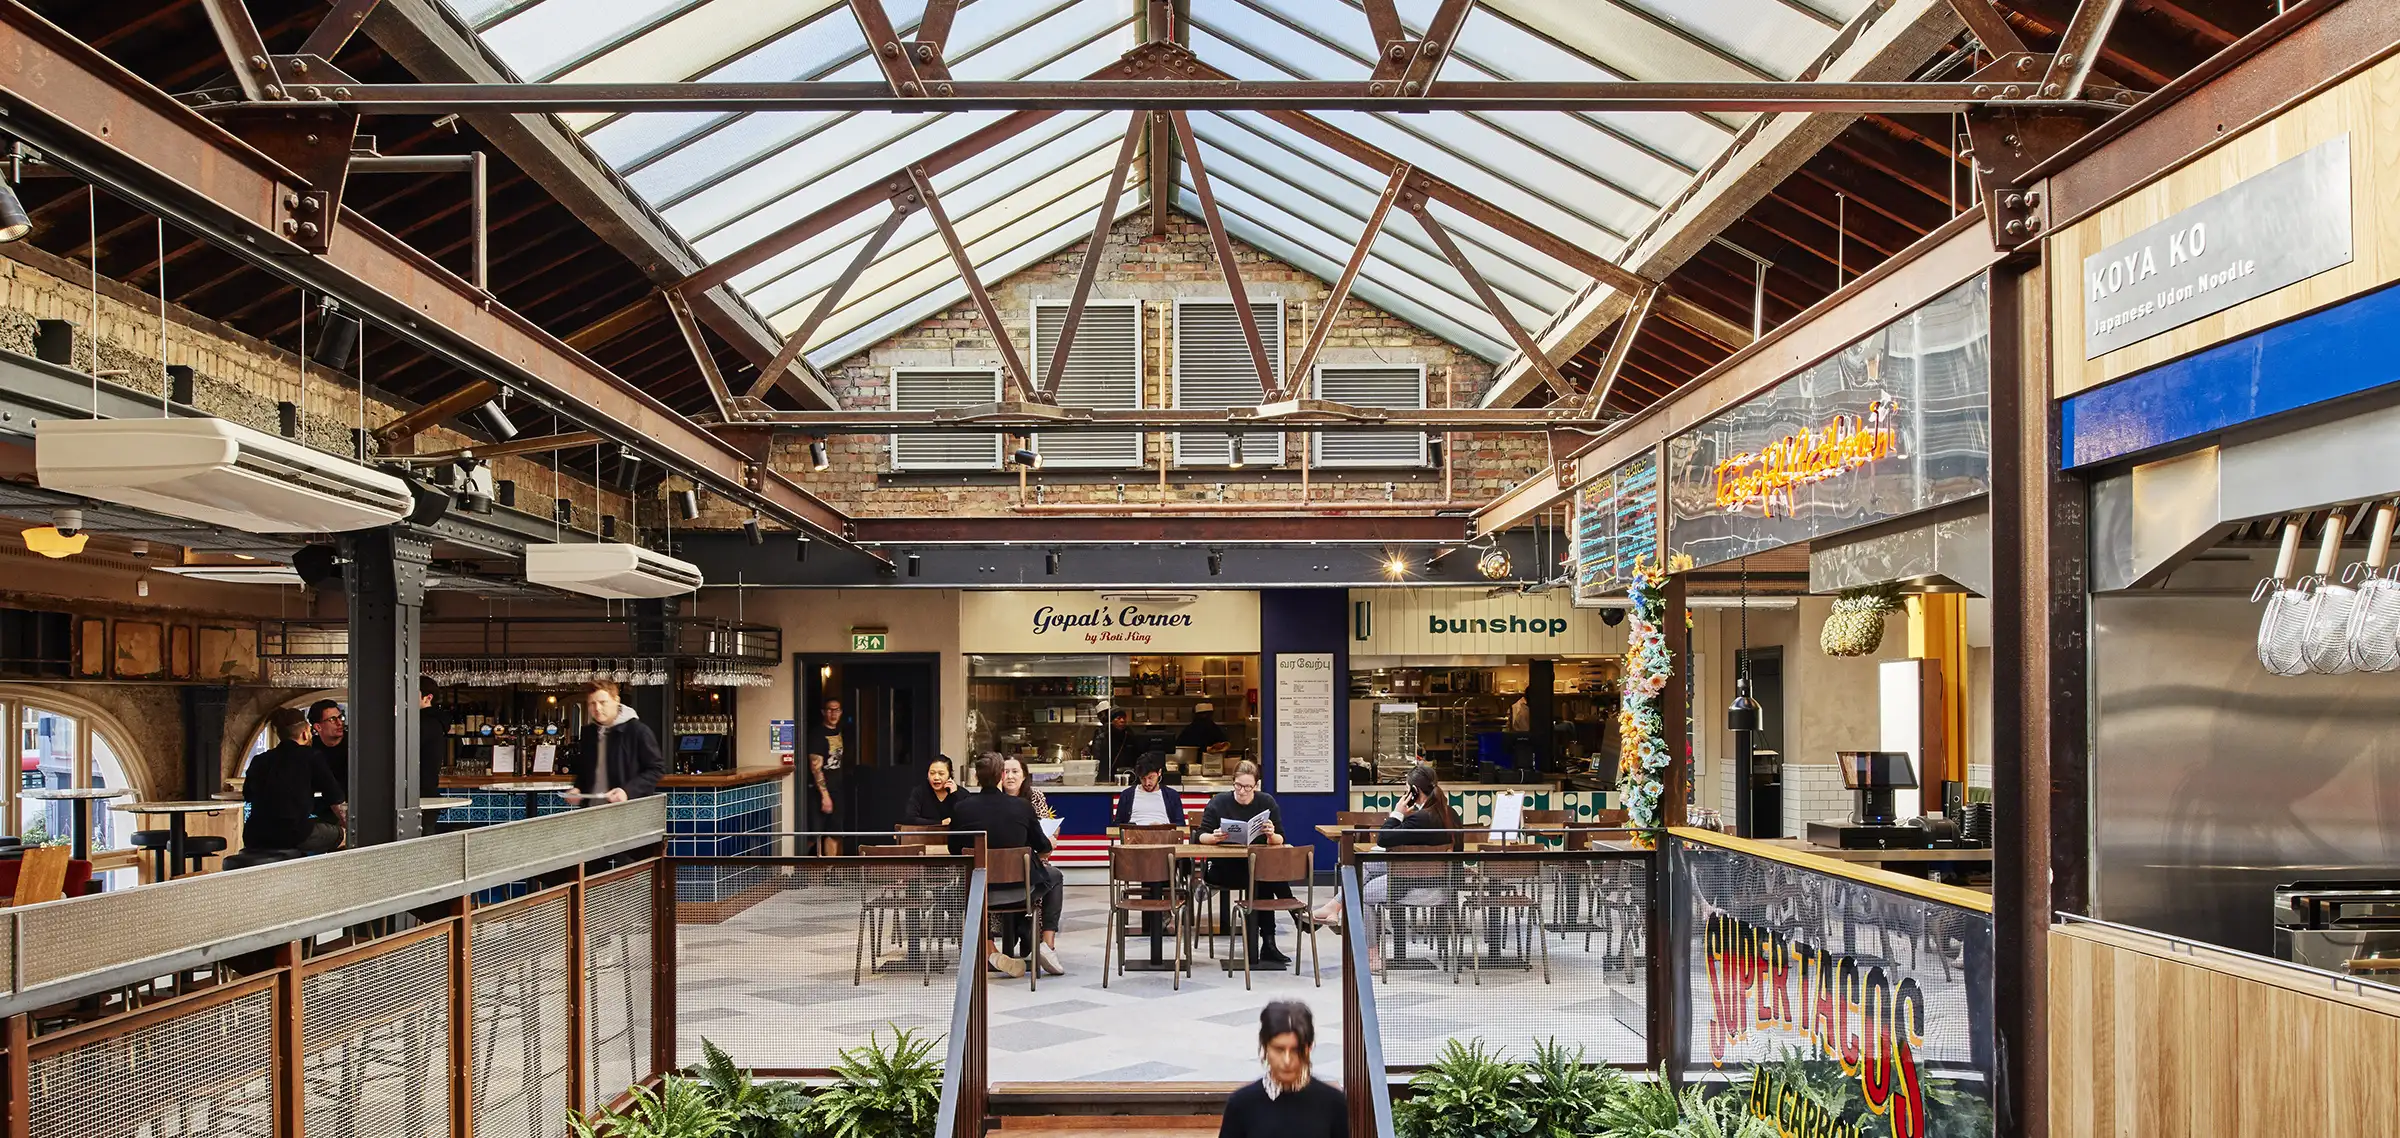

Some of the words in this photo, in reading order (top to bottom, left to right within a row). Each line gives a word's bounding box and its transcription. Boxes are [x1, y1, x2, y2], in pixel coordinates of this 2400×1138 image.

[2091, 245, 2158, 303] KOYA
[2170, 222, 2207, 268] KO
[2093, 300, 2155, 337] Japanese
[2157, 284, 2194, 310] Udon
[2198, 259, 2256, 294] Noodle
[1033, 606, 1114, 635] Gopal's
[1119, 606, 1193, 627] Corner
[1430, 615, 1568, 638] bunshop
[1085, 632, 1098, 645] by
[1099, 631, 1124, 642] Roti
[1125, 631, 1152, 645] King
[1280, 657, 1331, 671] வரவேற்பு
[1705, 911, 1793, 1068] SUPER
[1792, 940, 1925, 1138] TACOS
